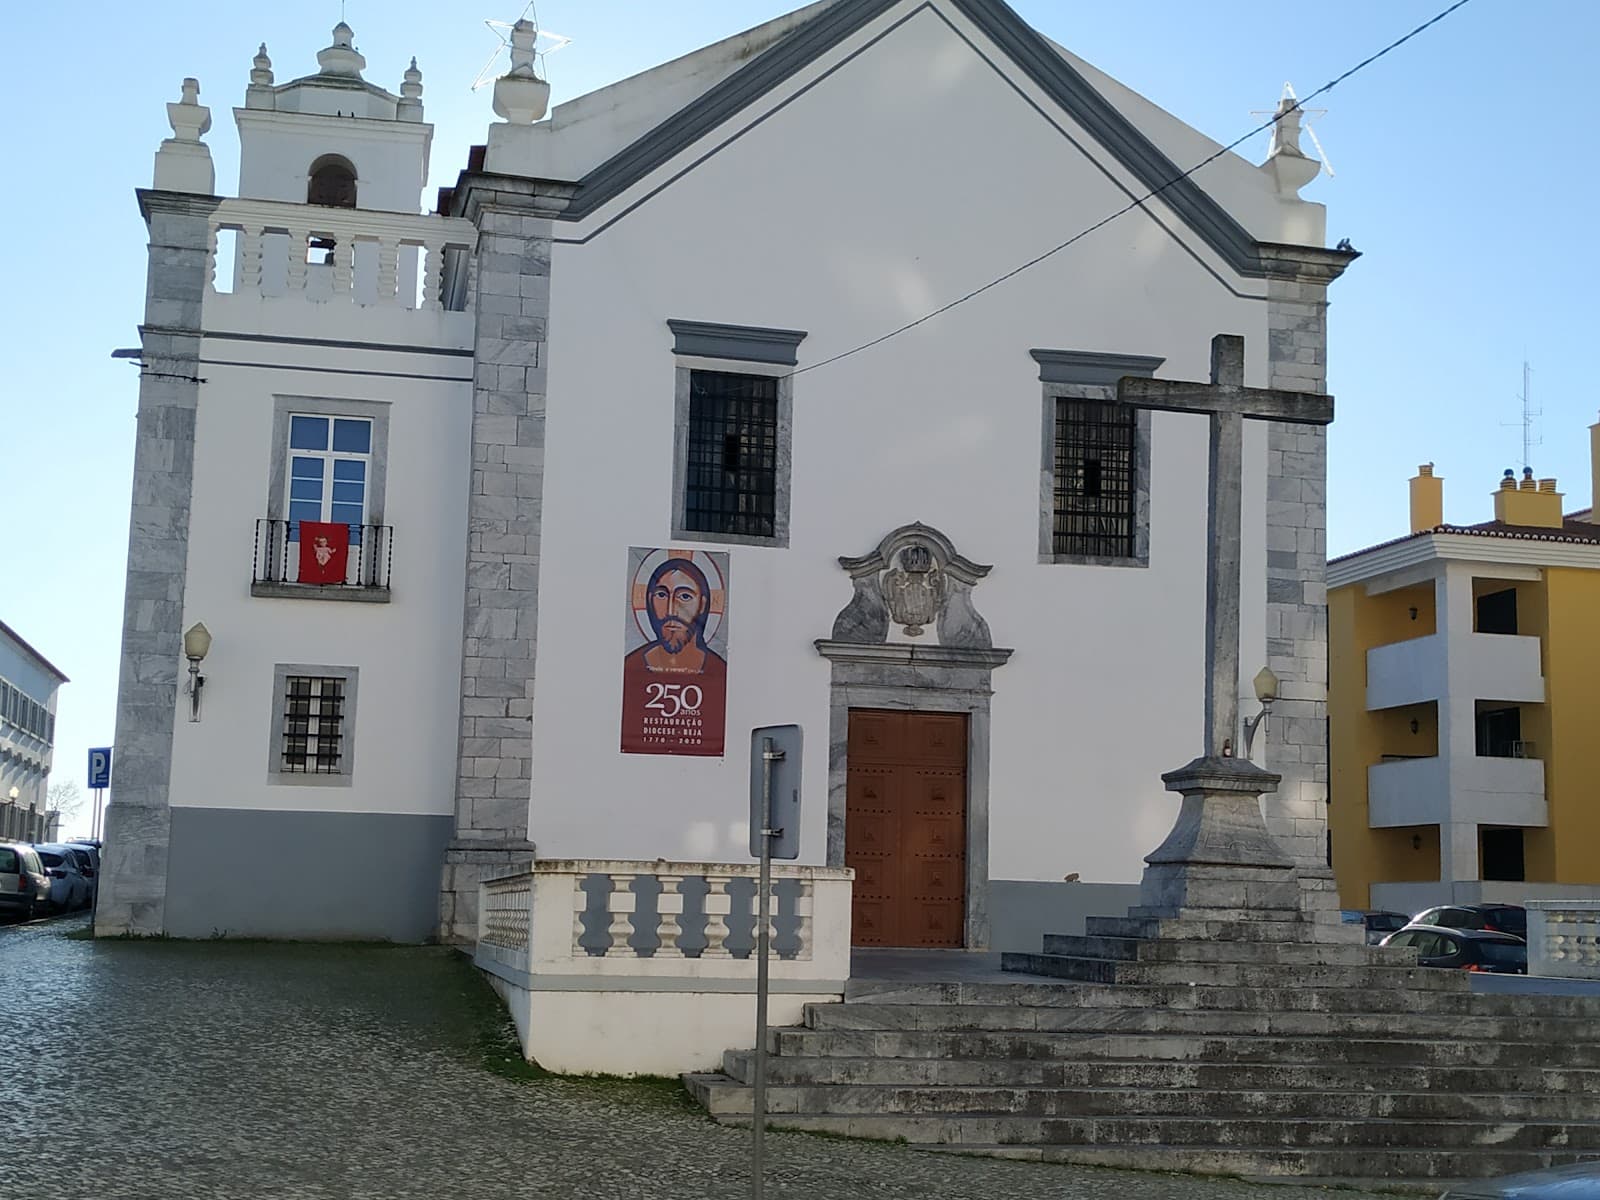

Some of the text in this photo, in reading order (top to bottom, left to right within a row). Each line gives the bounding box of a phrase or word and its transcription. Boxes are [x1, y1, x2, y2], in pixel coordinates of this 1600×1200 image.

[644, 683, 703, 717] 250
[643, 717, 702, 727] RESTAURAÇÃO
[643, 727, 676, 735] DIOCESE
[91, 752, 105, 784] P
